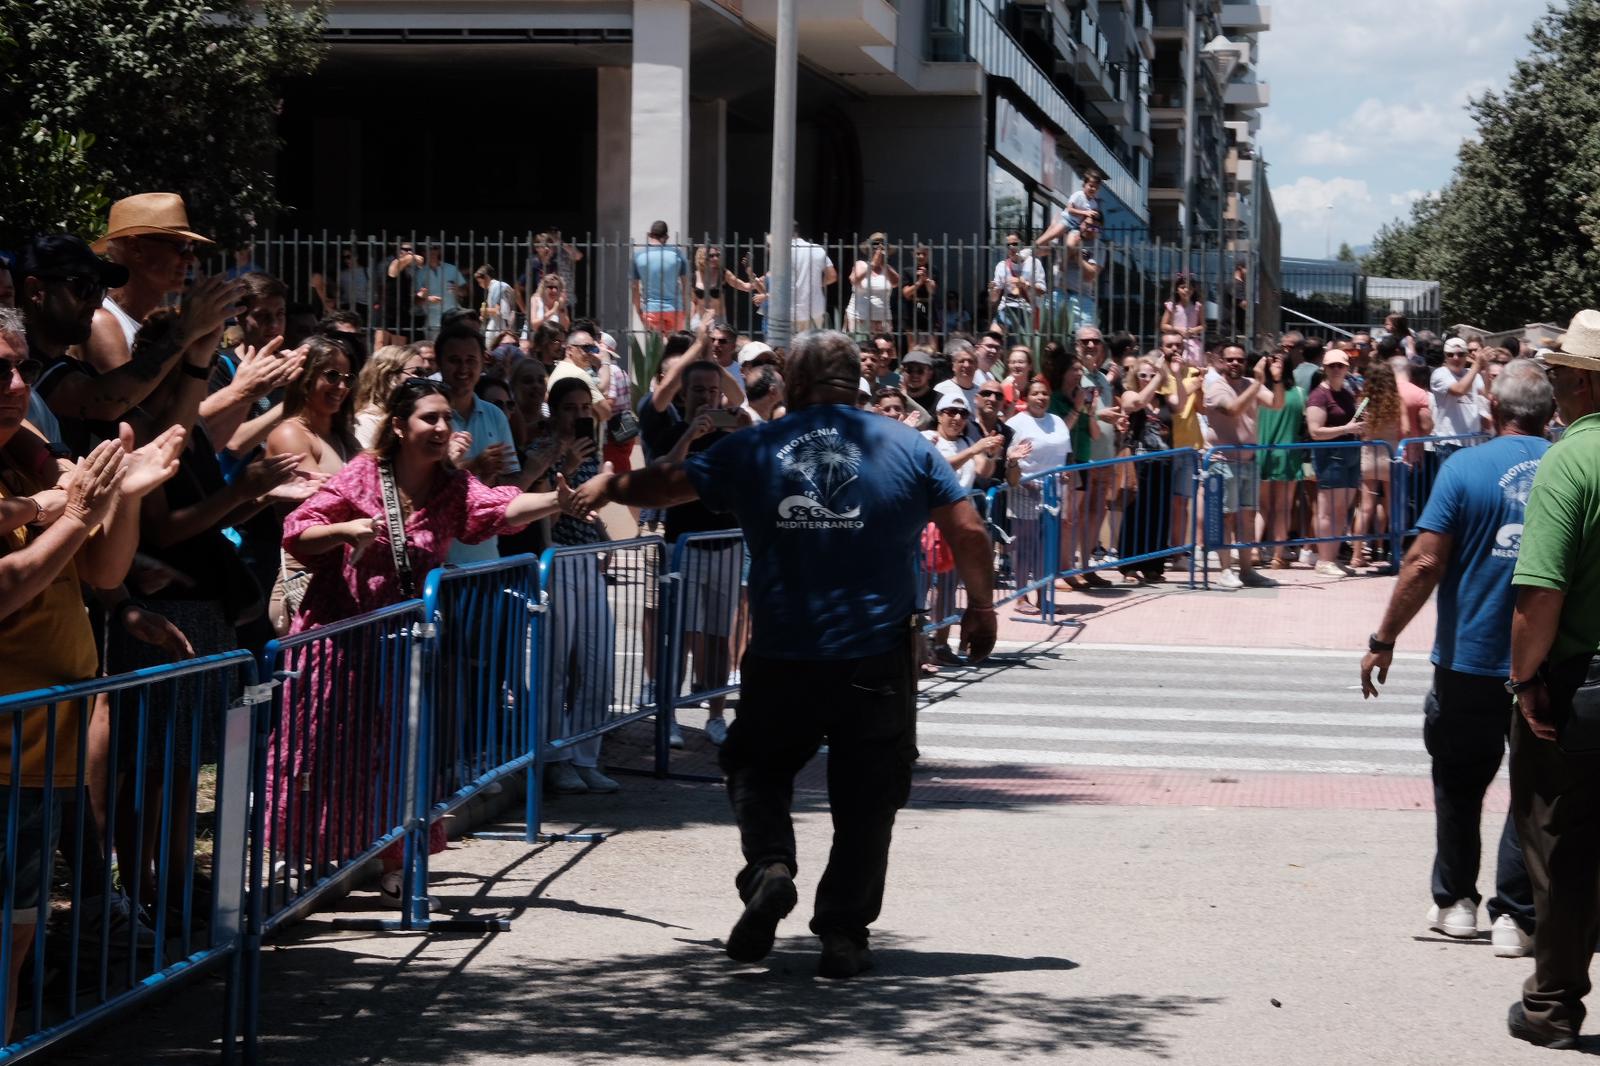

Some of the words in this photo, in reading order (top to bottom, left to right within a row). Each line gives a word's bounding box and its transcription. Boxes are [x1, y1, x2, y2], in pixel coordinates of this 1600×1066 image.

[776, 427, 839, 460] PIROTECNIA
[1498, 459, 1541, 488] PIROTECN
[776, 521, 865, 529] MEDITERRANEO
